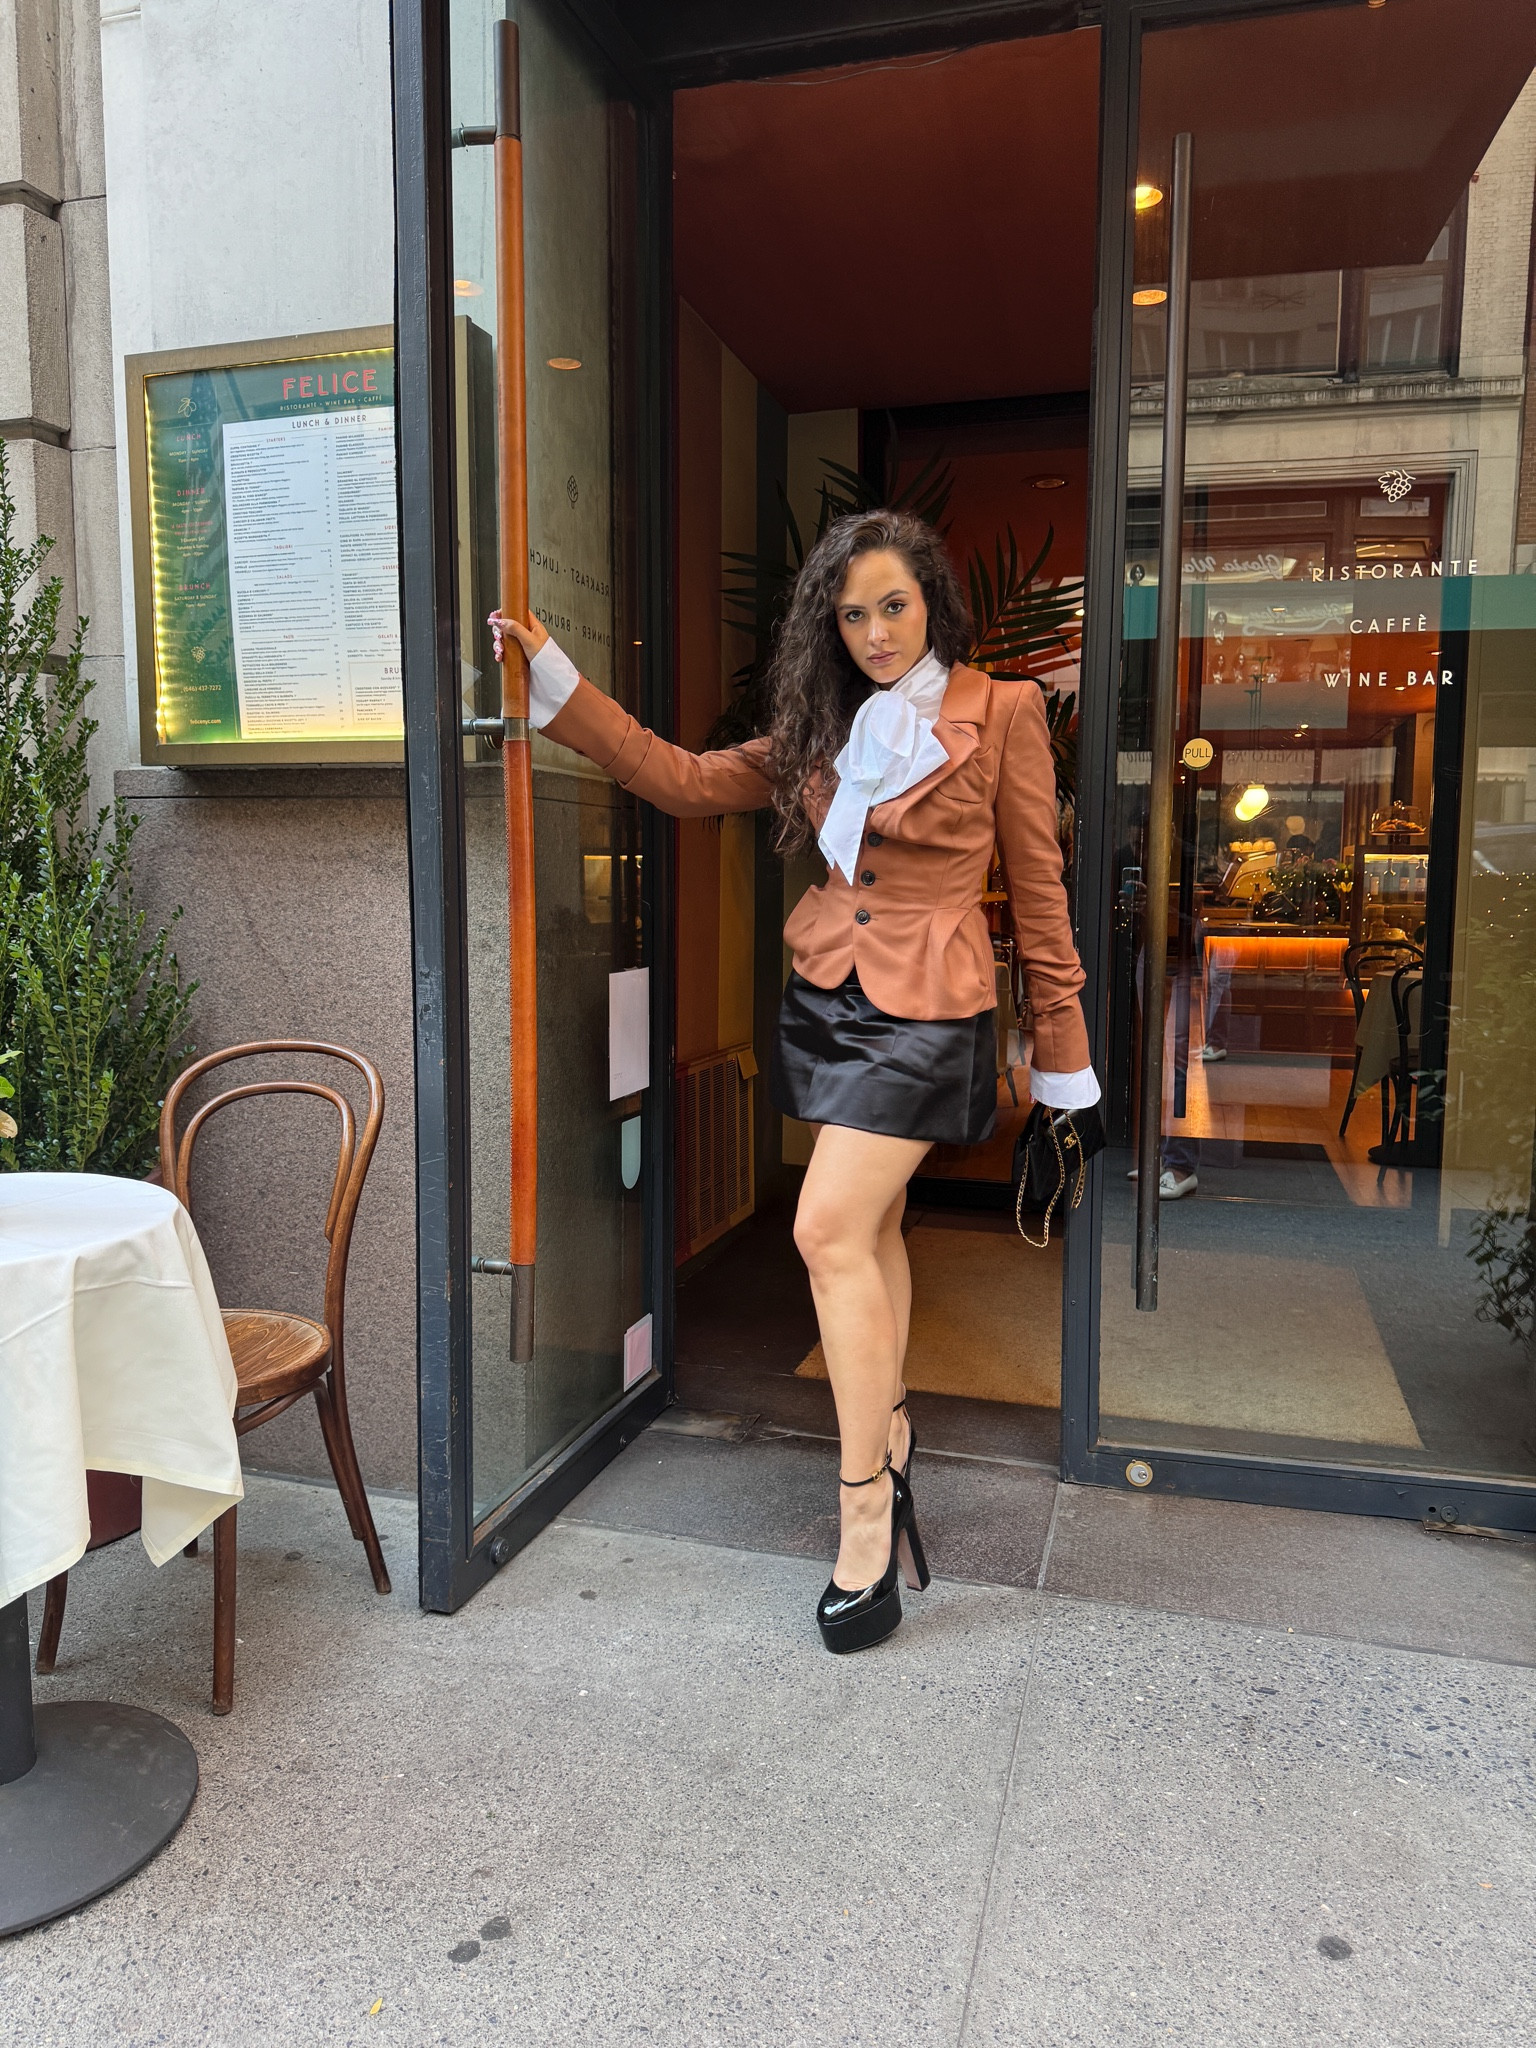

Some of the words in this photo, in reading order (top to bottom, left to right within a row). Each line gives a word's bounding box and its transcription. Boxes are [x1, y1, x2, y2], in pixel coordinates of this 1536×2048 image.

[282, 369, 378, 400] FELICE
[279, 402, 317, 411] RISTORANTE
[325, 399, 341, 407] WINE
[343, 397, 356, 405] BAR
[291, 417, 320, 429] LUNCH
[324, 417, 331, 426] &
[334, 414, 368, 425] DINNER
[175, 432, 201, 442] LUNCH
[1311, 559, 1479, 583] RISTORANTE
[177, 582, 212, 592] BRUNCH
[1349, 613, 1428, 634] CAFFÈ
[384, 667, 400, 675] BRU
[1323, 671, 1388, 688] WINE
[1406, 670, 1455, 686] BAR
[1184, 747, 1211, 758] PULL
